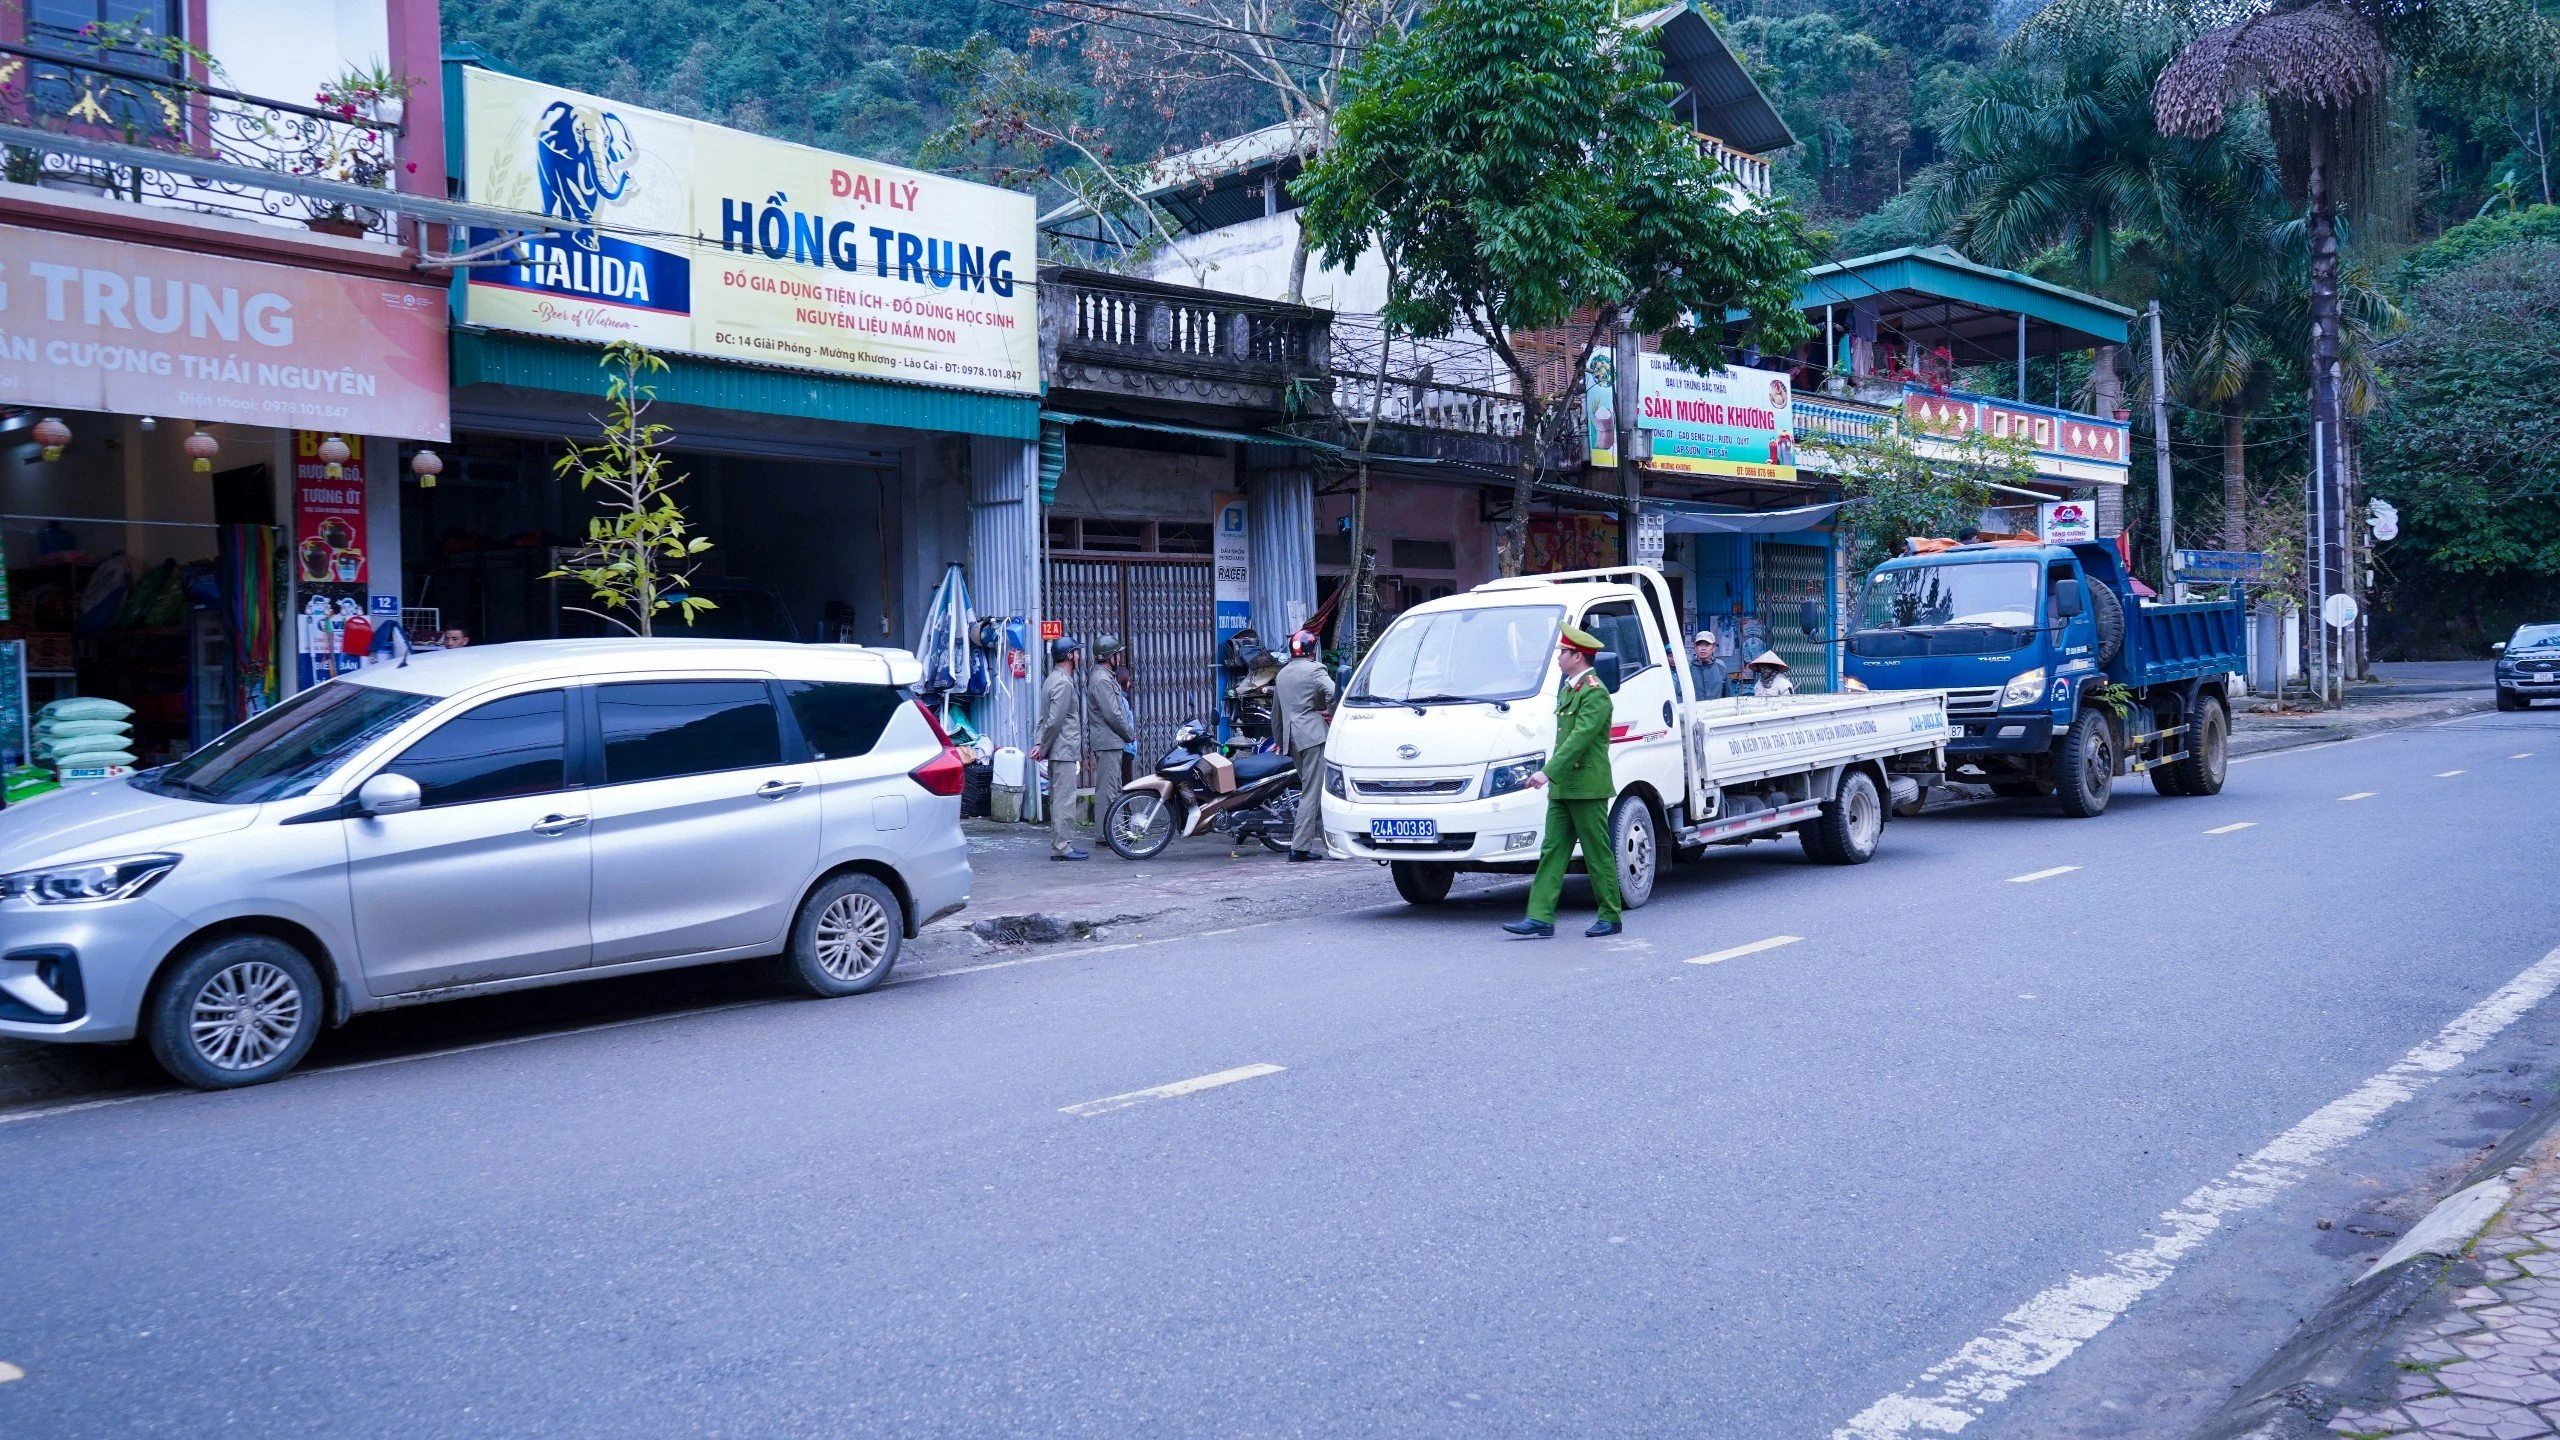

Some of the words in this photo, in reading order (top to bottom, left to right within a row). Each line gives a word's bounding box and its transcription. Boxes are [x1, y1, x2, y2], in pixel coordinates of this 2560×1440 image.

[831, 169, 880, 211] ĐẠI
[890, 180, 919, 212] LÝ
[722, 190, 857, 272] HỒNG
[869, 225, 1014, 298] TRUNG
[519, 241, 650, 302] HALIDA
[29, 261, 294, 347] TRUNG
[538, 302, 568, 323] Beer
[571, 309, 583, 327] of
[585, 308, 632, 330] Vietnam
[724, 269, 746, 288] ĐỒ
[751, 276, 776, 294] GIA
[780, 280, 822, 300] DỤNG
[825, 286, 856, 307] TIỆN
[859, 290, 882, 310] ÍCH
[892, 295, 913, 314] ĐỒ
[916, 301, 953, 320] DÙNG
[956, 310, 983, 327] HỌC
[986, 312, 1014, 329] SINH
[796, 308, 855, 331] NGUYÊN
[859, 316, 888, 337] LIỆU
[891, 319, 924, 339] MẦM
[927, 328, 956, 344] NON
[46, 340, 172, 376] CƯƠNG
[178, 353, 250, 385] THÁI
[259, 363, 376, 397] NGUYÊN
[716, 332, 735, 345] ĐC:
[738, 336, 751, 347] 14
[754, 337, 775, 350] Giải
[777, 340, 812, 357] Phóng
[819, 346, 856, 363] Mường
[858, 350, 897, 369] Khương
[904, 357, 921, 369] Lào
[923, 360, 938, 371] Cai
[945, 363, 960, 374] ĐT:
[962, 365, 1022, 381] 0978.101.847
[178, 390, 215, 407] Điện
[217, 395, 258, 413] thoại:
[262, 400, 348, 418] 0978.101.847
[1644, 390, 1672, 420] SẢN
[1676, 397, 1724, 425] MƯỜNG
[1727, 405, 1776, 431] KHƯƠNG
[299, 430, 361, 460] BN
[1218, 566, 1246, 581] RACER
[378, 597, 391, 608] 12
[1042, 623, 1052, 634] 12
[1053, 623, 1059, 634] A
[1373, 820, 1433, 836] 24A-003.83
